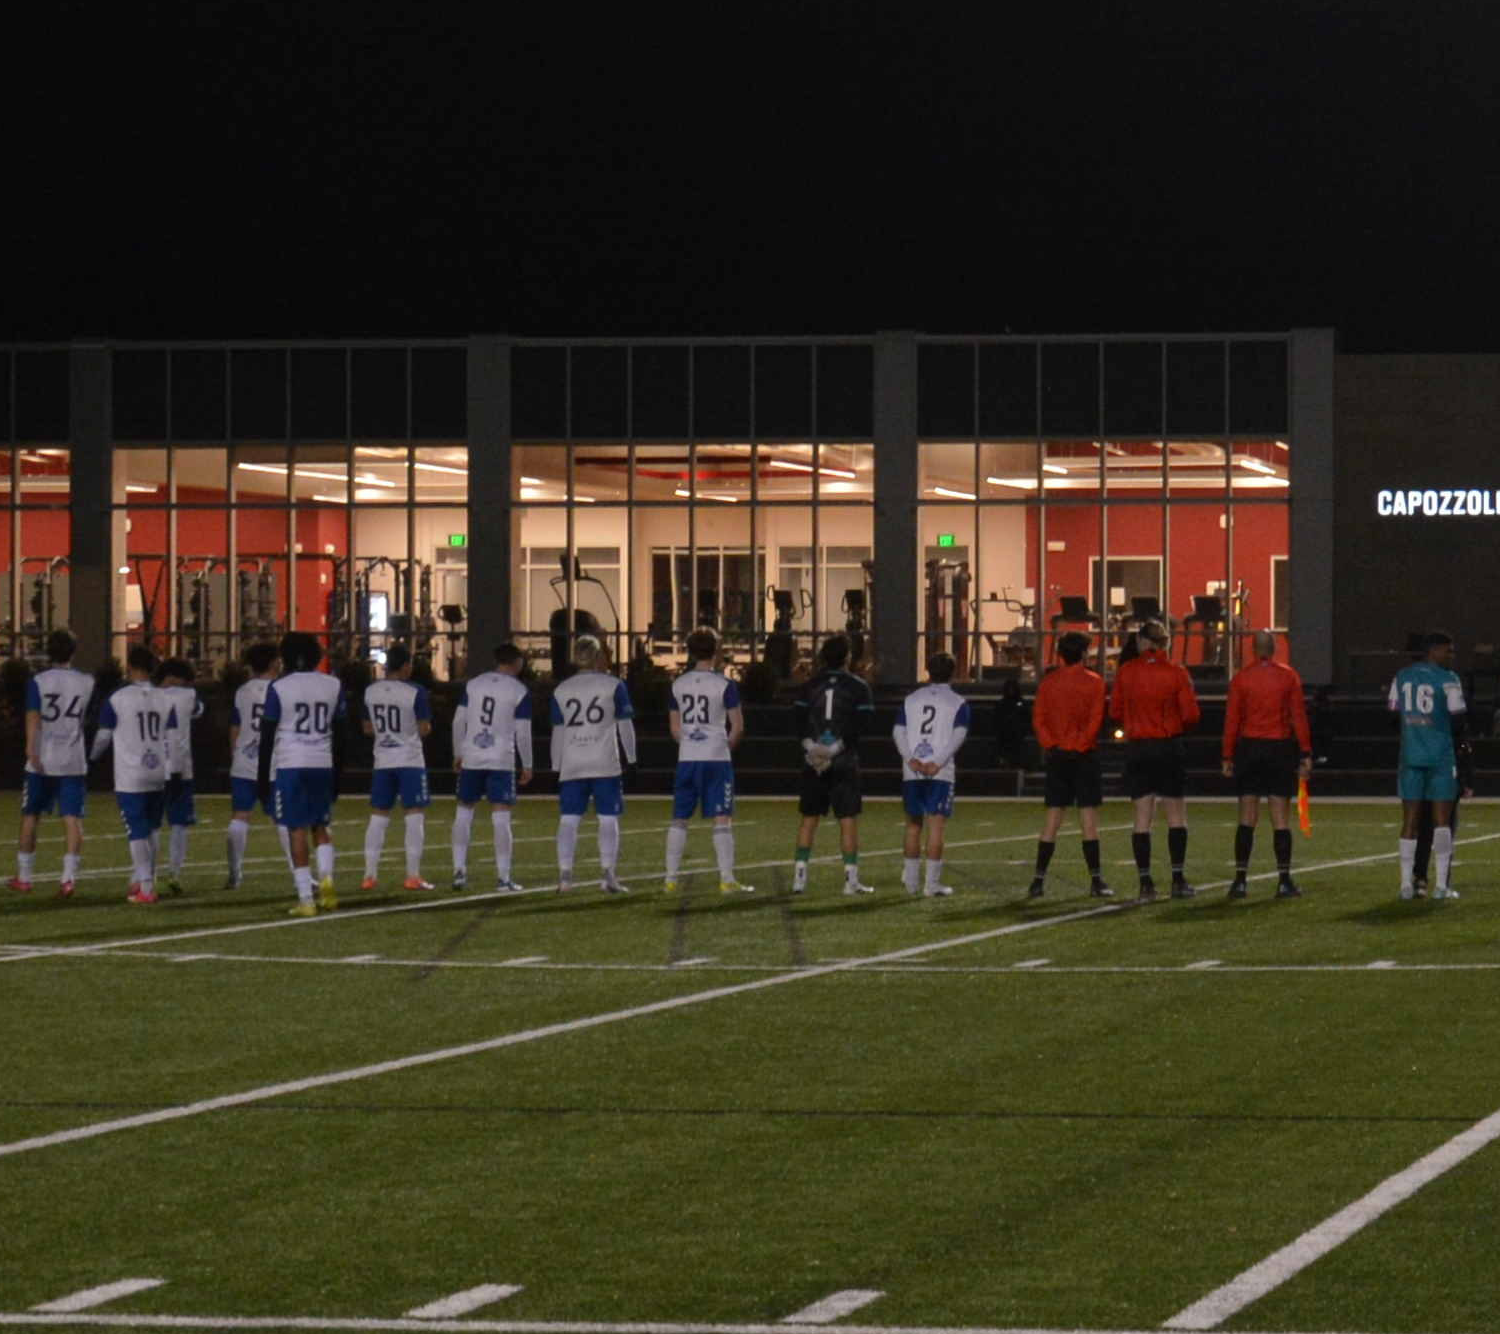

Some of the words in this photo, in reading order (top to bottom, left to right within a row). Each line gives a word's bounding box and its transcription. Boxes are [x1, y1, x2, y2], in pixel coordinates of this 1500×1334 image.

[42, 693, 83, 722] 34
[480, 696, 496, 726] 9
[565, 696, 605, 727] 26
[682, 694, 709, 724] 23
[825, 688, 833, 720] 1
[1401, 681, 1434, 714] 16
[137, 711, 160, 742] 10
[295, 702, 329, 734] 20
[373, 704, 402, 734] 50
[920, 705, 936, 735] 2
